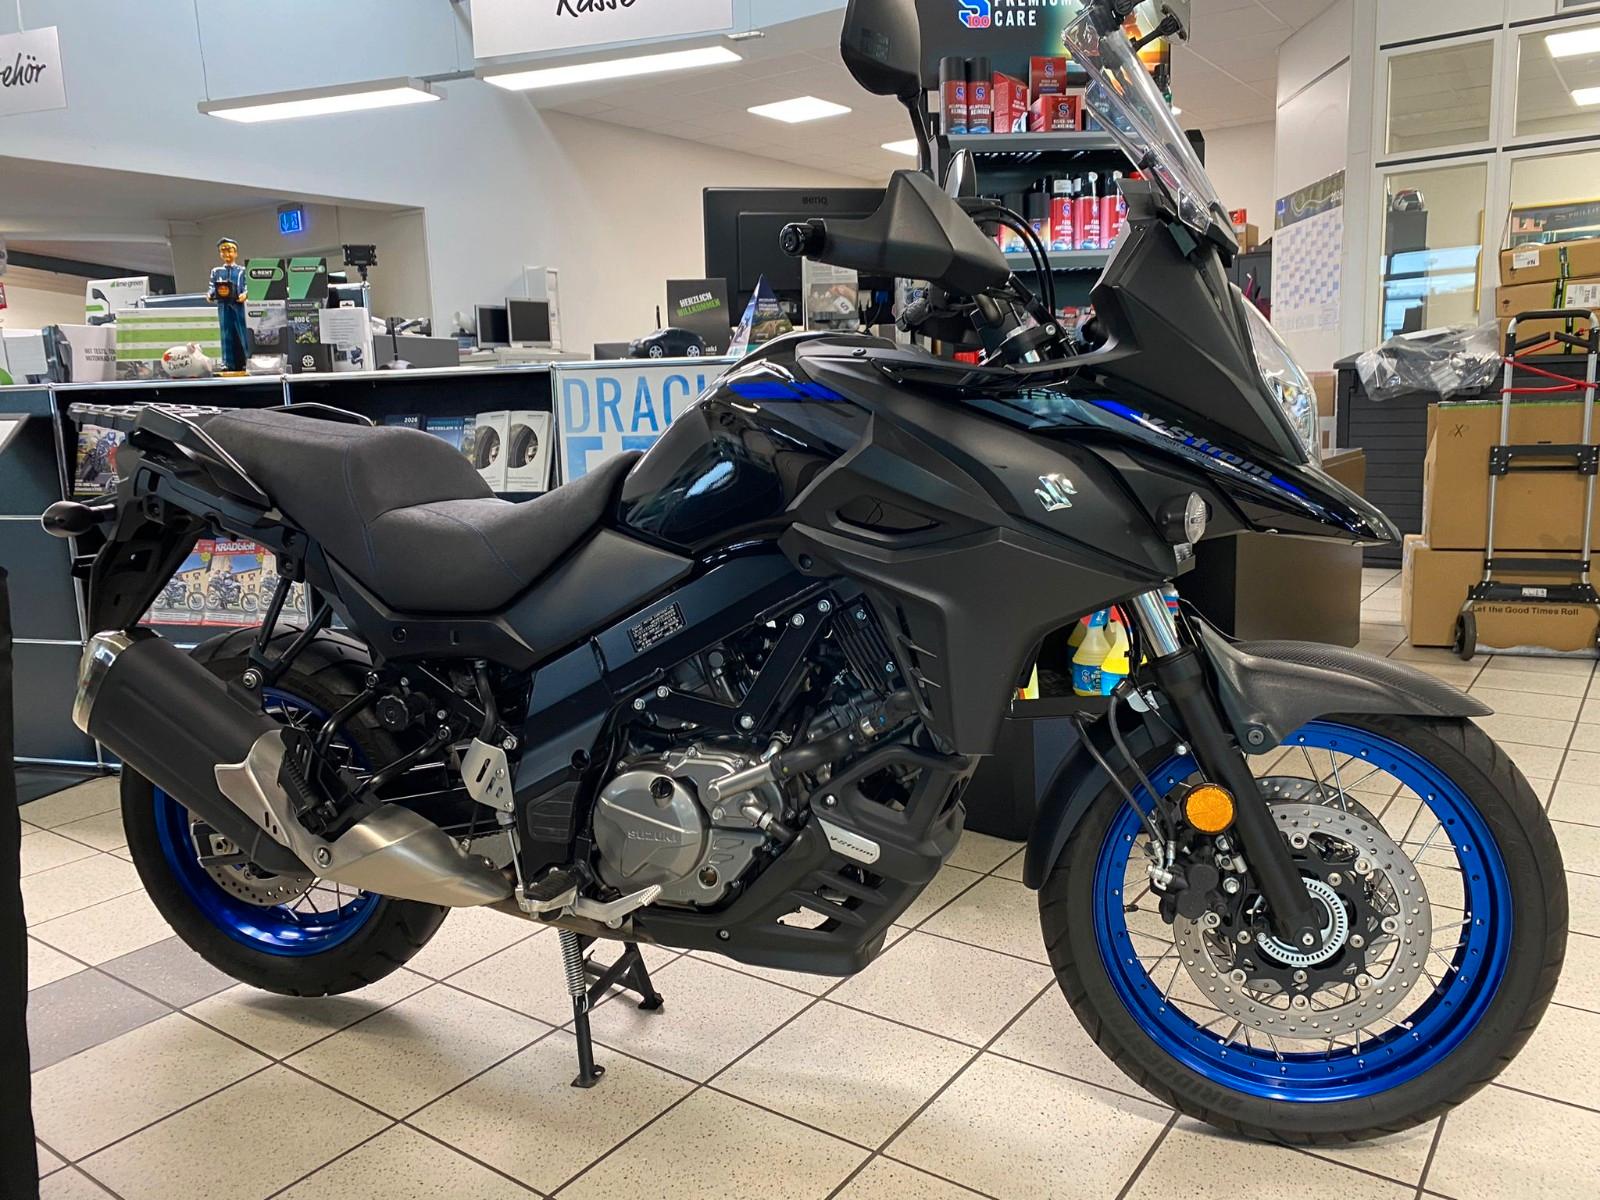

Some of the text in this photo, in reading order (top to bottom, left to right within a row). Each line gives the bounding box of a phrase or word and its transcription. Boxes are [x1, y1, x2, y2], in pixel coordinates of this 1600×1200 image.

[994, 10, 1037, 27] CARE
[0, 52, 47, 87] ehör
[676, 298, 721, 316] WILLKOMMEN
[679, 292, 712, 308] HERZLICH
[562, 374, 705, 433] DRAC
[1472, 605, 1486, 613] Let
[1488, 605, 1503, 613] the
[1505, 606, 1530, 614] Good
[1532, 607, 1559, 615] Times
[627, 830, 681, 843] SUZUKI
